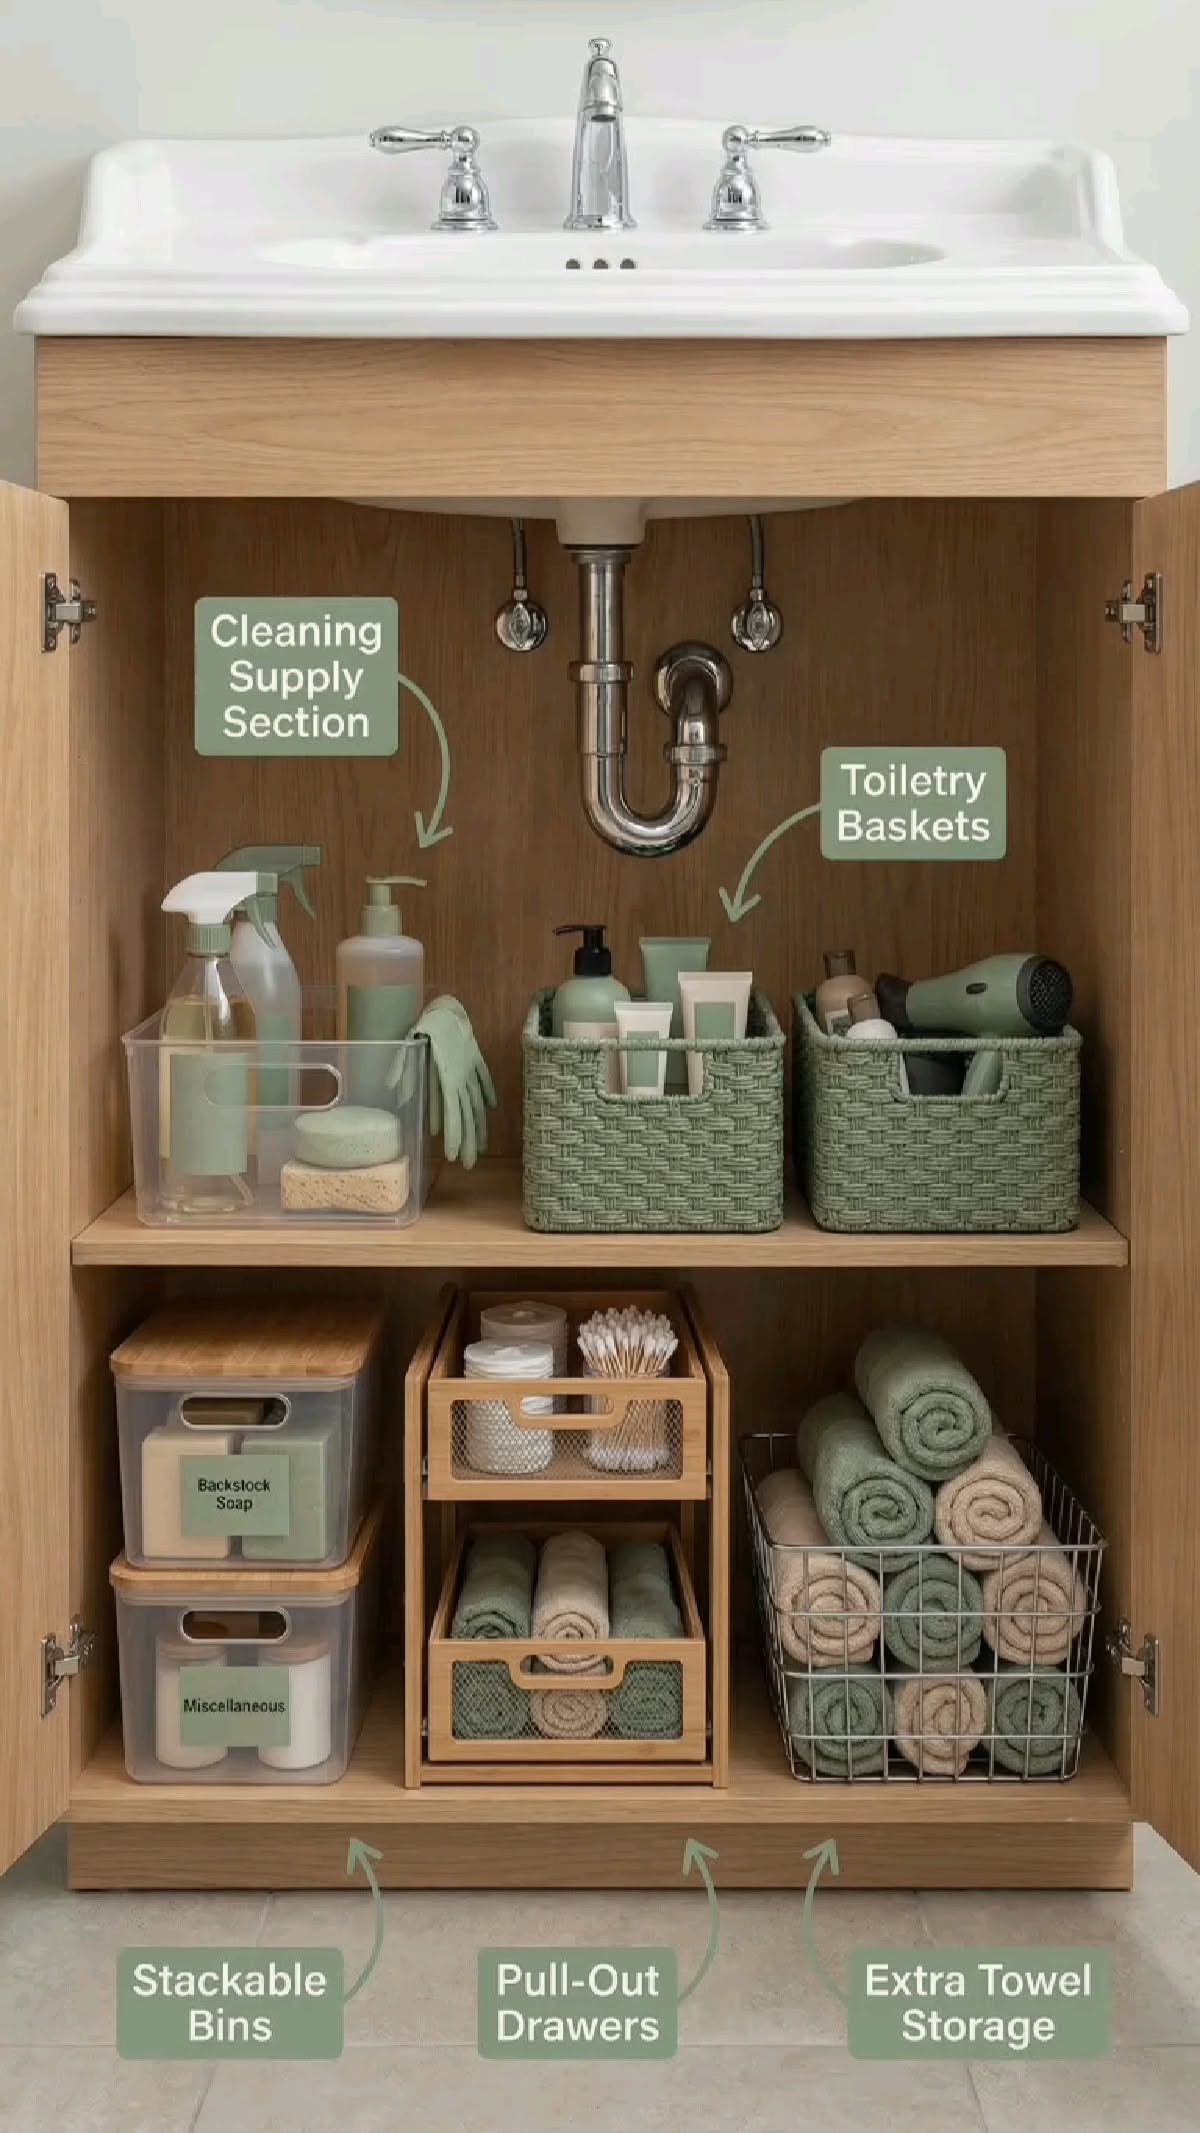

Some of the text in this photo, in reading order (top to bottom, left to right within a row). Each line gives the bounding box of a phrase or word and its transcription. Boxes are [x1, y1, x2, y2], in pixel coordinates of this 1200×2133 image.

[197, 1477, 271, 1493] Backstock
[216, 1495, 254, 1513] Soap
[183, 1697, 286, 1714] Miscellaneous
